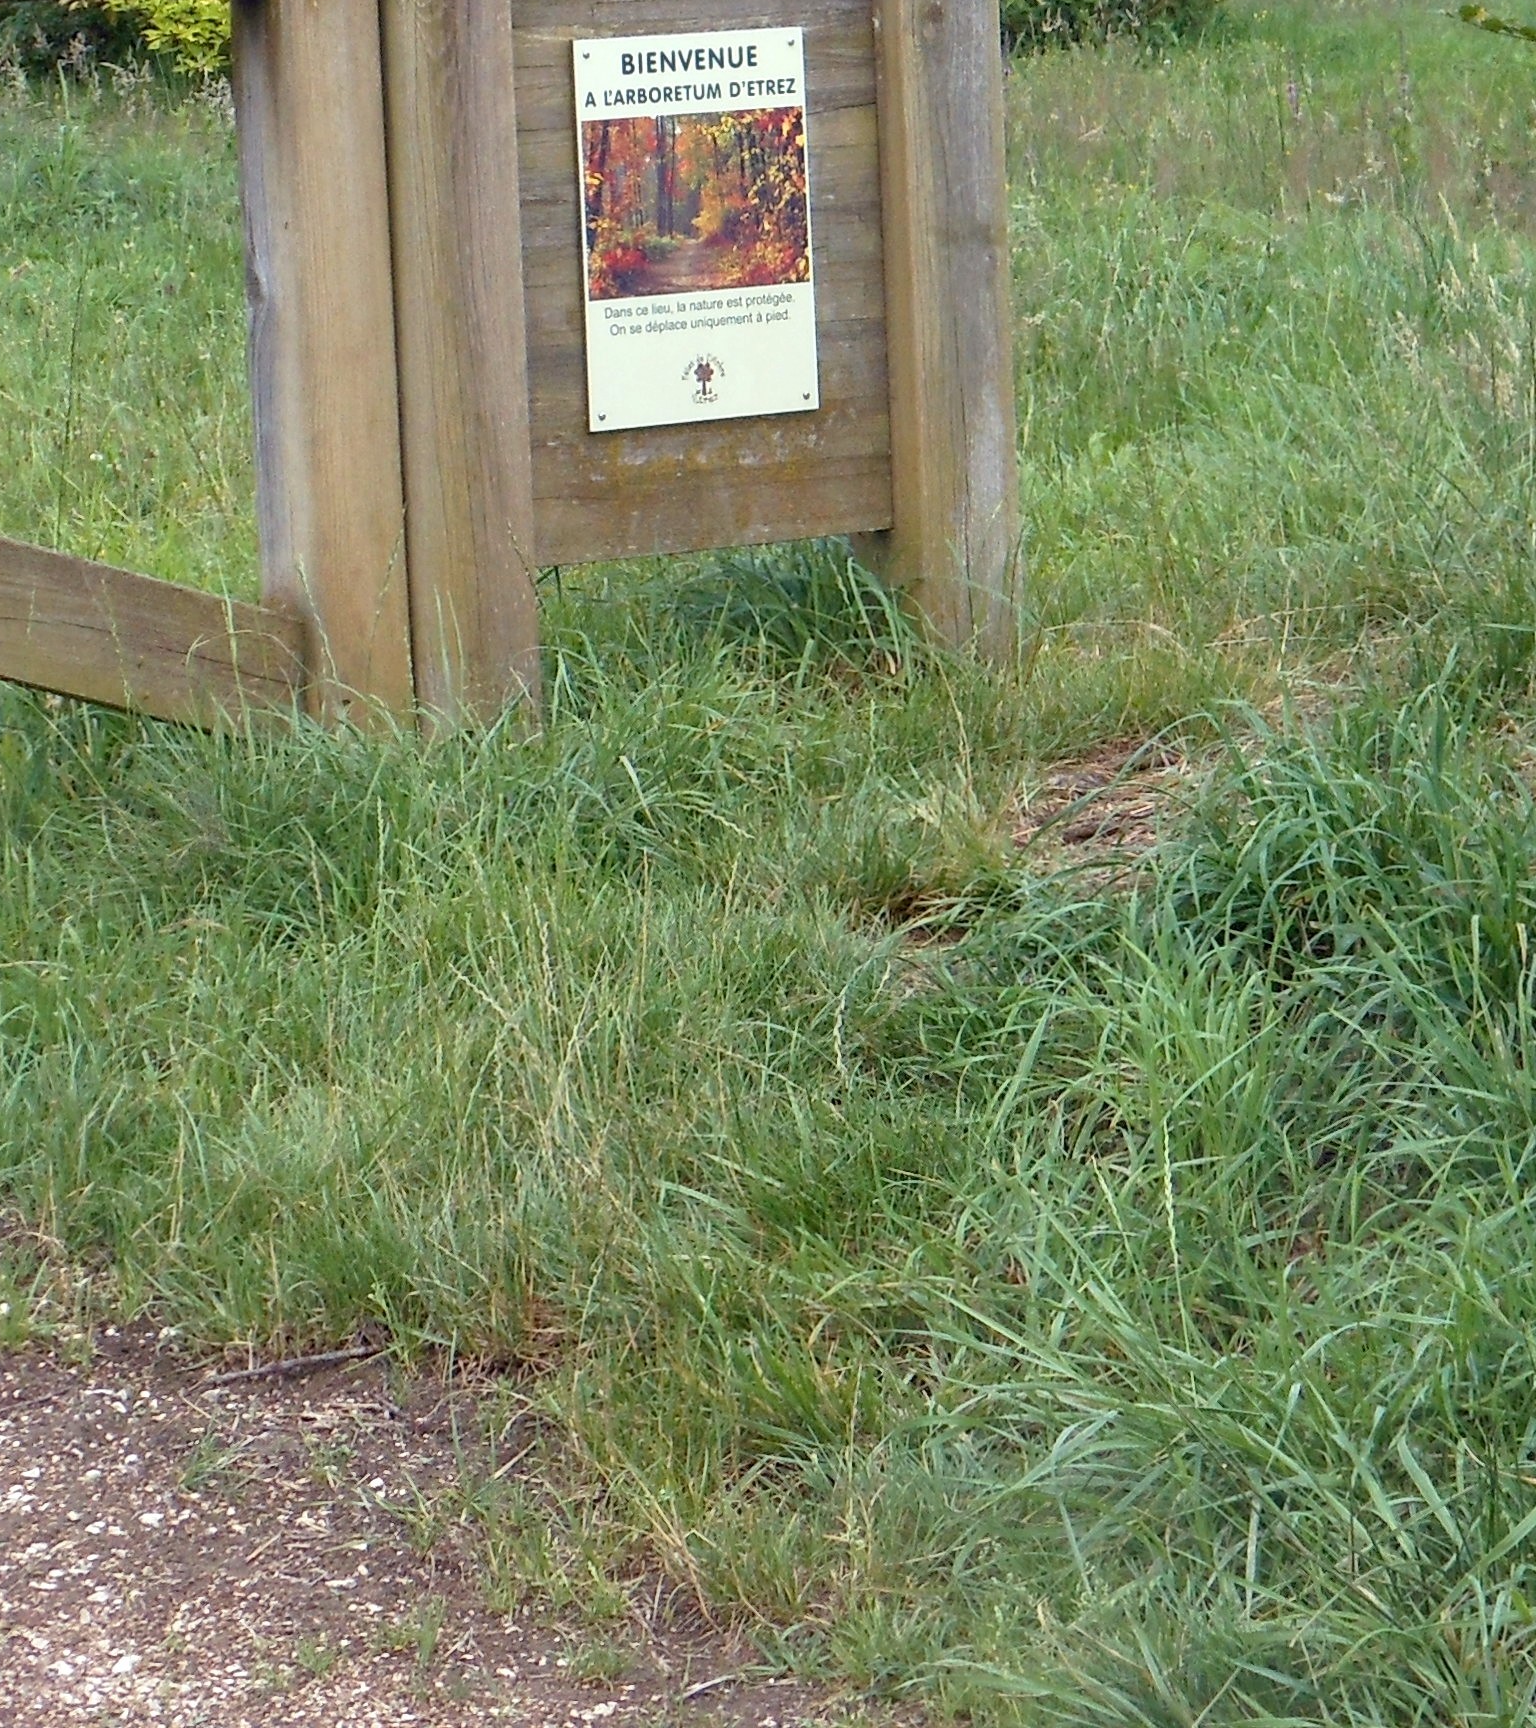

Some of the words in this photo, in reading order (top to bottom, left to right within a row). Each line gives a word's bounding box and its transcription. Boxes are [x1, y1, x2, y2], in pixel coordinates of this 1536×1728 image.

[621, 45, 759, 76] BIENVENUE
[584, 91, 597, 109] A
[603, 82, 723, 108] L'ARBORETUM
[729, 78, 797, 101] D'ETREZ
[604, 307, 633, 320] Dans
[636, 308, 649, 317] ce
[651, 303, 674, 316] lieu,
[677, 301, 686, 313] la
[689, 299, 724, 312] nature
[726, 296, 743, 308] est
[745, 292, 796, 310] protégée.
[609, 324, 627, 337] On
[629, 325, 642, 335] se
[645, 319, 688, 335] déplace
[690, 312, 753, 330] uniquement
[755, 311, 763, 323] à
[765, 308, 792, 325] pied.
